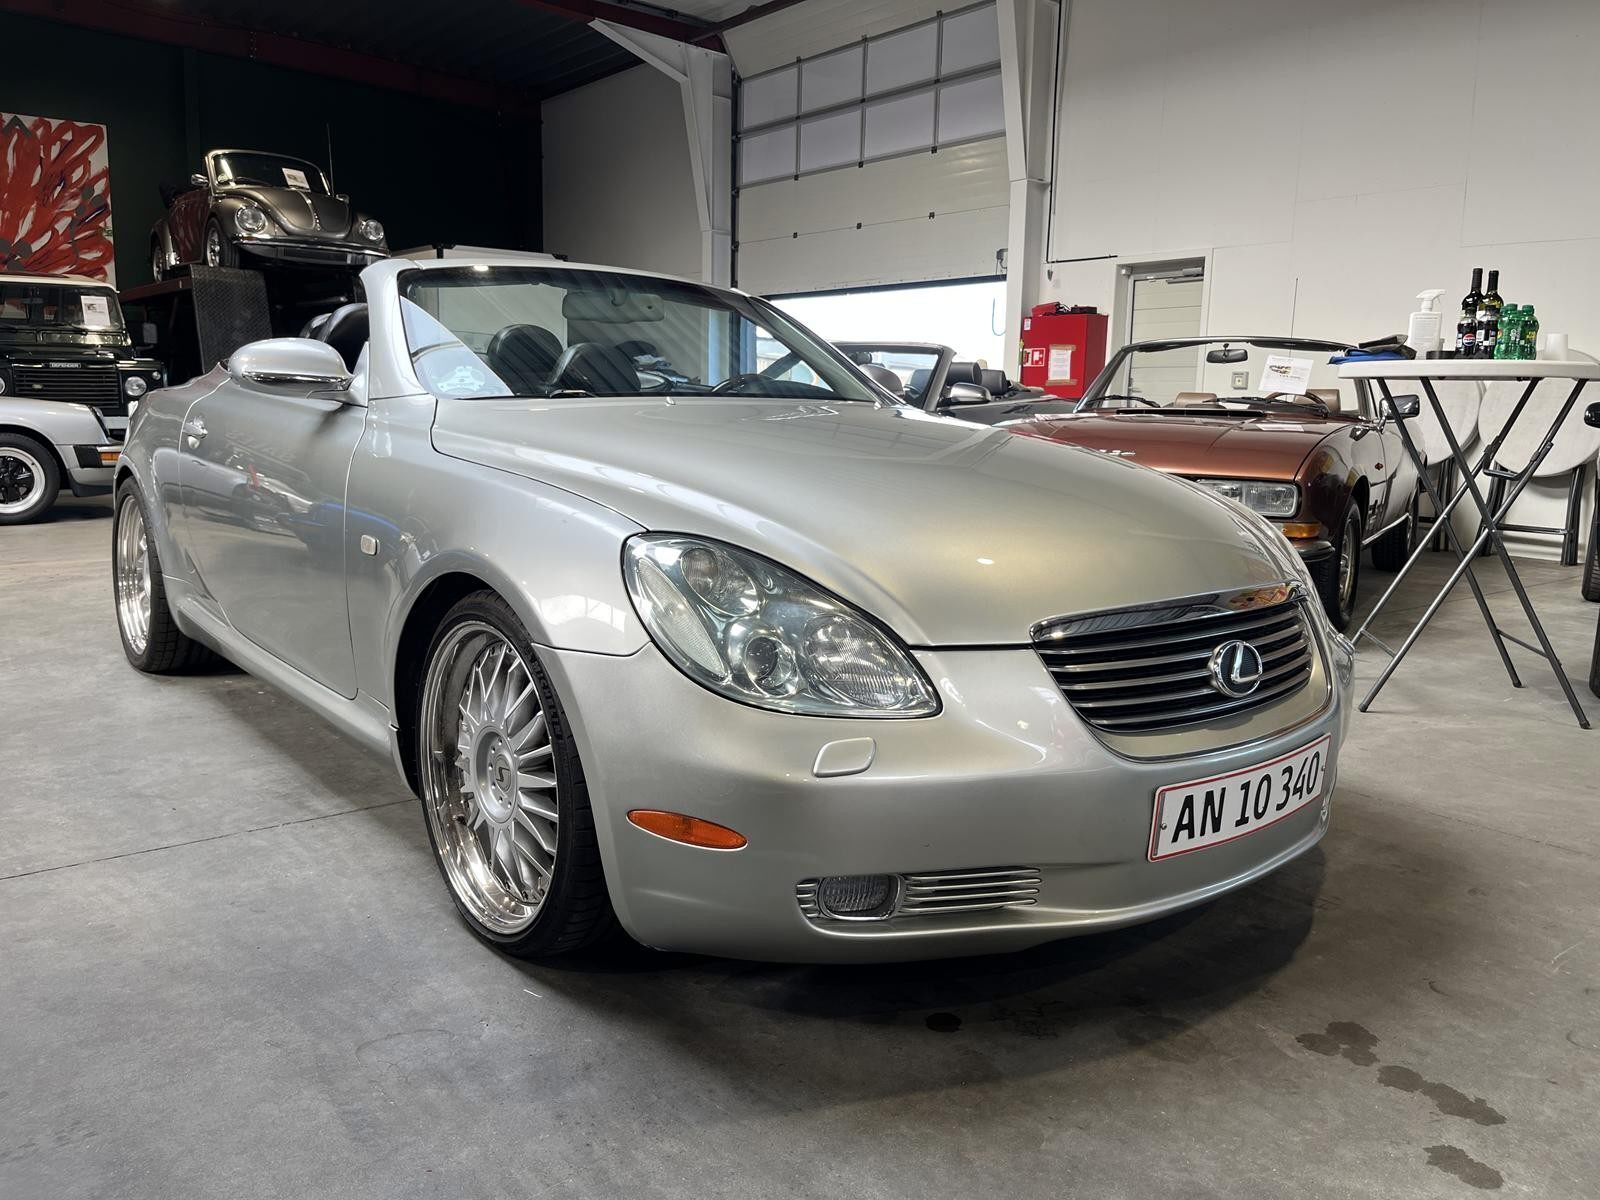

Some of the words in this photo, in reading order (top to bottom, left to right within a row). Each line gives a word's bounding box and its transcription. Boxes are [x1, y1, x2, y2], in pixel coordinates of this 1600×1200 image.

[530, 659, 564, 739] MICHELIN
[1171, 786, 1227, 843] AN
[1234, 773, 1272, 828] 10
[1275, 750, 1320, 811] 340
